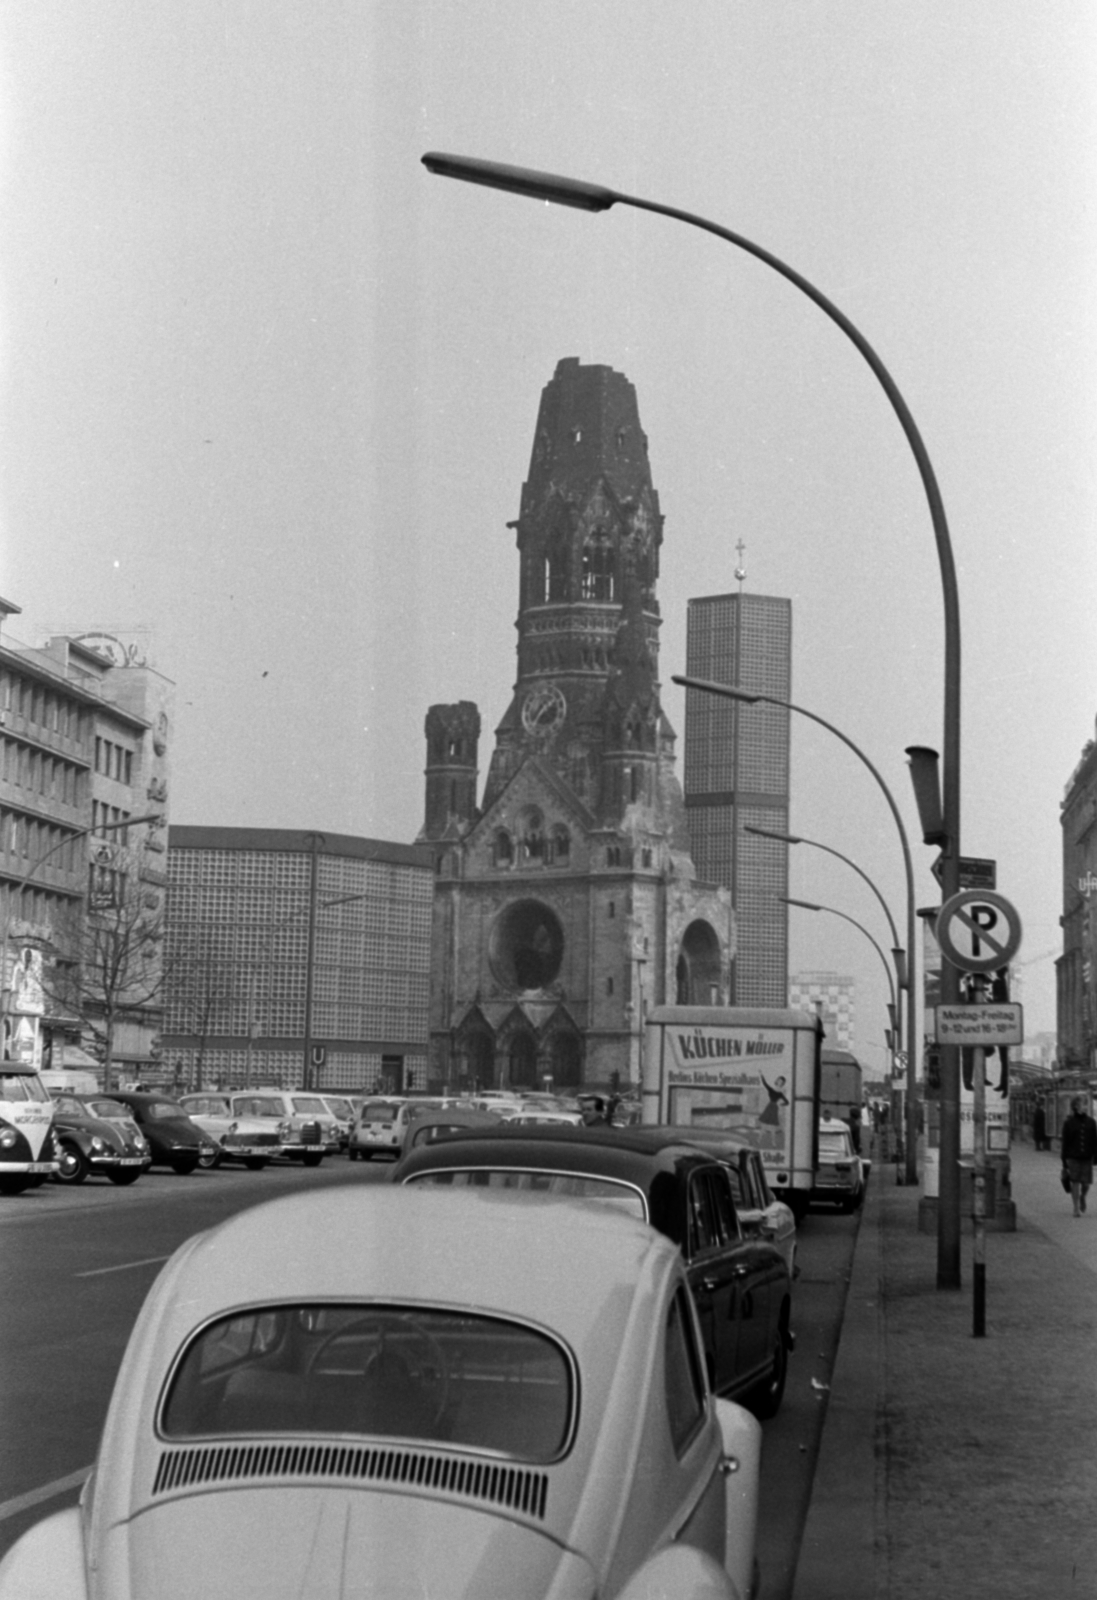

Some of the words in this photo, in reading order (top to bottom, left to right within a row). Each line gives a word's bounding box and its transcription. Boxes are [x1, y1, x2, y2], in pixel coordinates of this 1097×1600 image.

[971, 905, 997, 957] P
[313, 1048, 325, 1065] U
[678, 1028, 742, 1059] KÜCHEN
